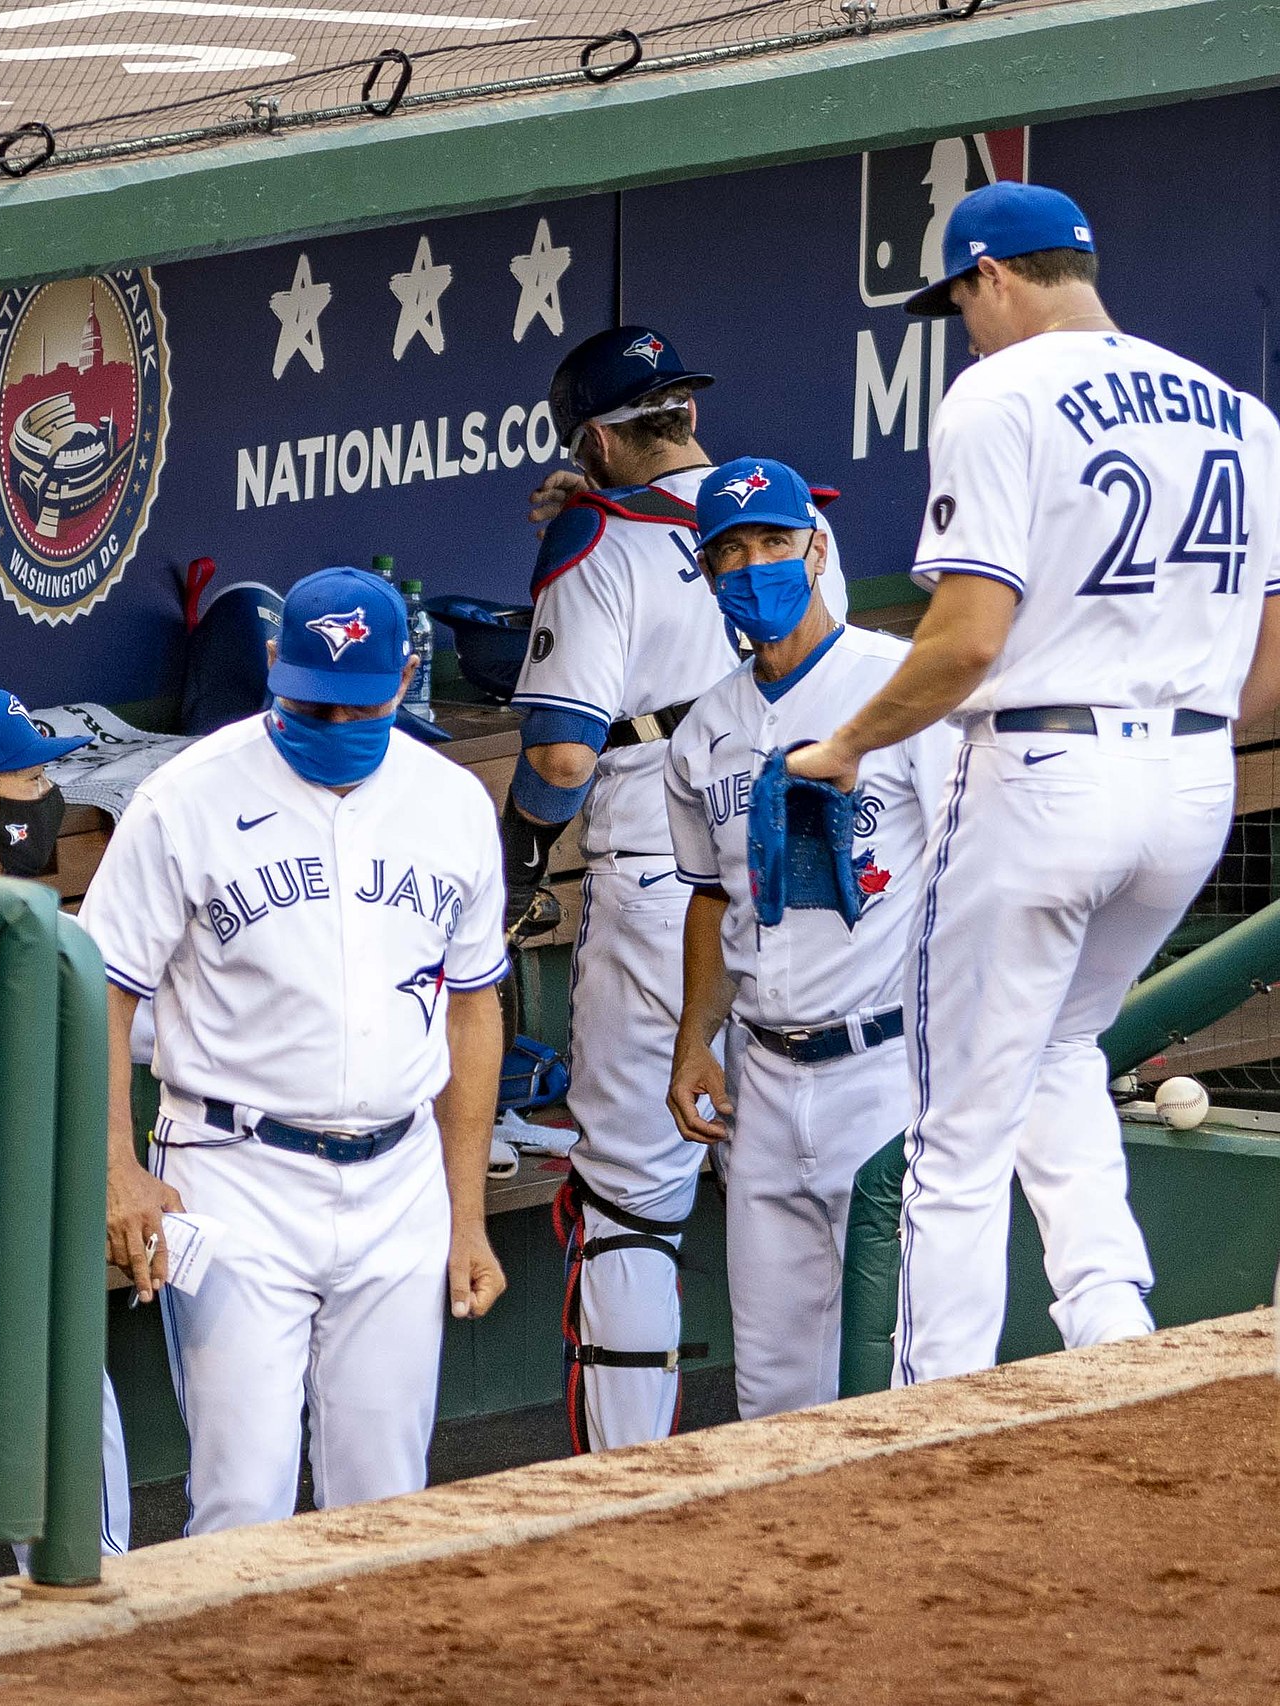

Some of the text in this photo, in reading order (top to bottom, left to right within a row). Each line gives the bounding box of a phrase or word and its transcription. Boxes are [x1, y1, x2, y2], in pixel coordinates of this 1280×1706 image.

[1055, 371, 1244, 446] PEARSON
[236, 400, 569, 511] NATIONALS.CO
[1074, 449, 1250, 597] 24
[9, 534, 119, 598] WASHINGTON DC
[705, 770, 752, 830] UE
[207, 857, 463, 945] BLUE JAYS
